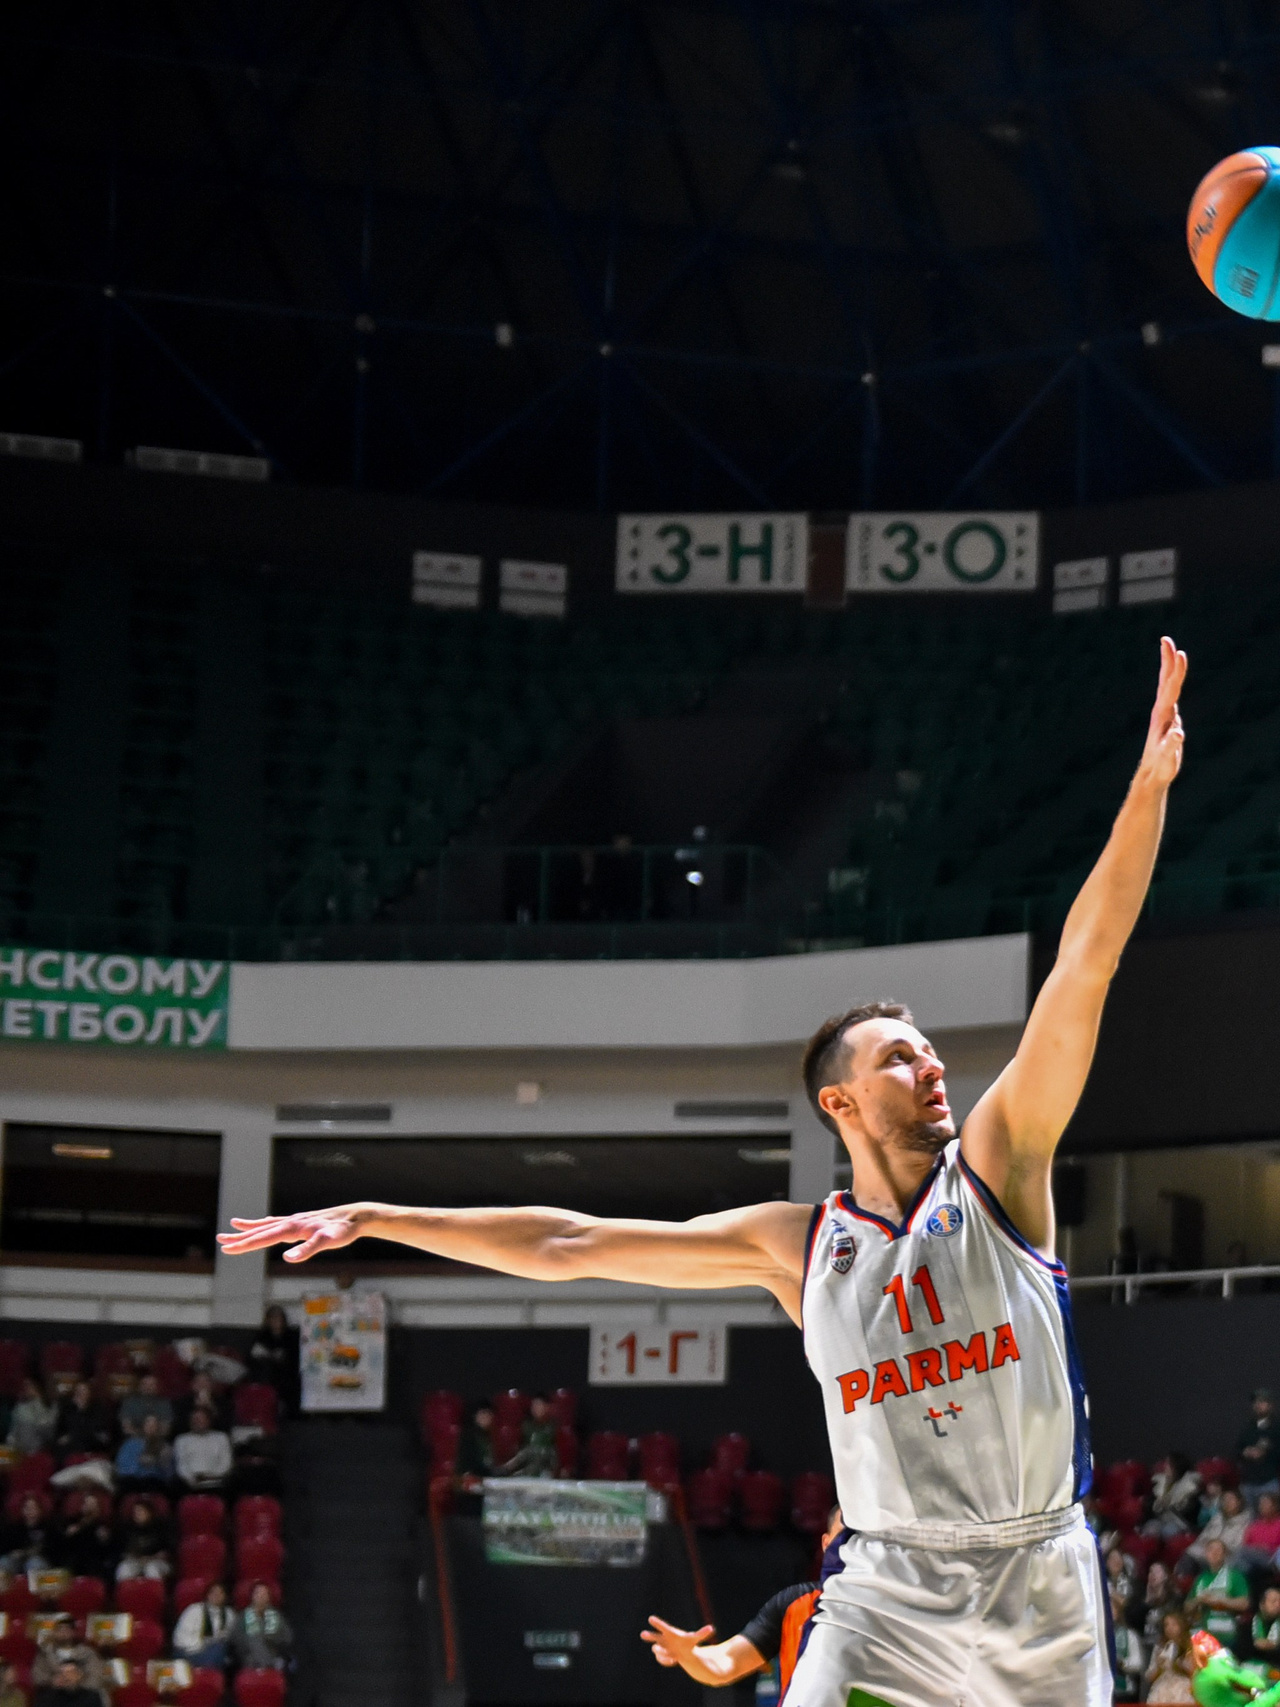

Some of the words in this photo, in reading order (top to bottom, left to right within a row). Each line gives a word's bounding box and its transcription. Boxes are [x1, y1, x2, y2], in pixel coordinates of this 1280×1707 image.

[0, 949, 224, 998] НСКОМУ
[882, 1264, 945, 1335] 11
[616, 1330, 699, 1375] 1-Г
[835, 1322, 1021, 1415] PARMA
